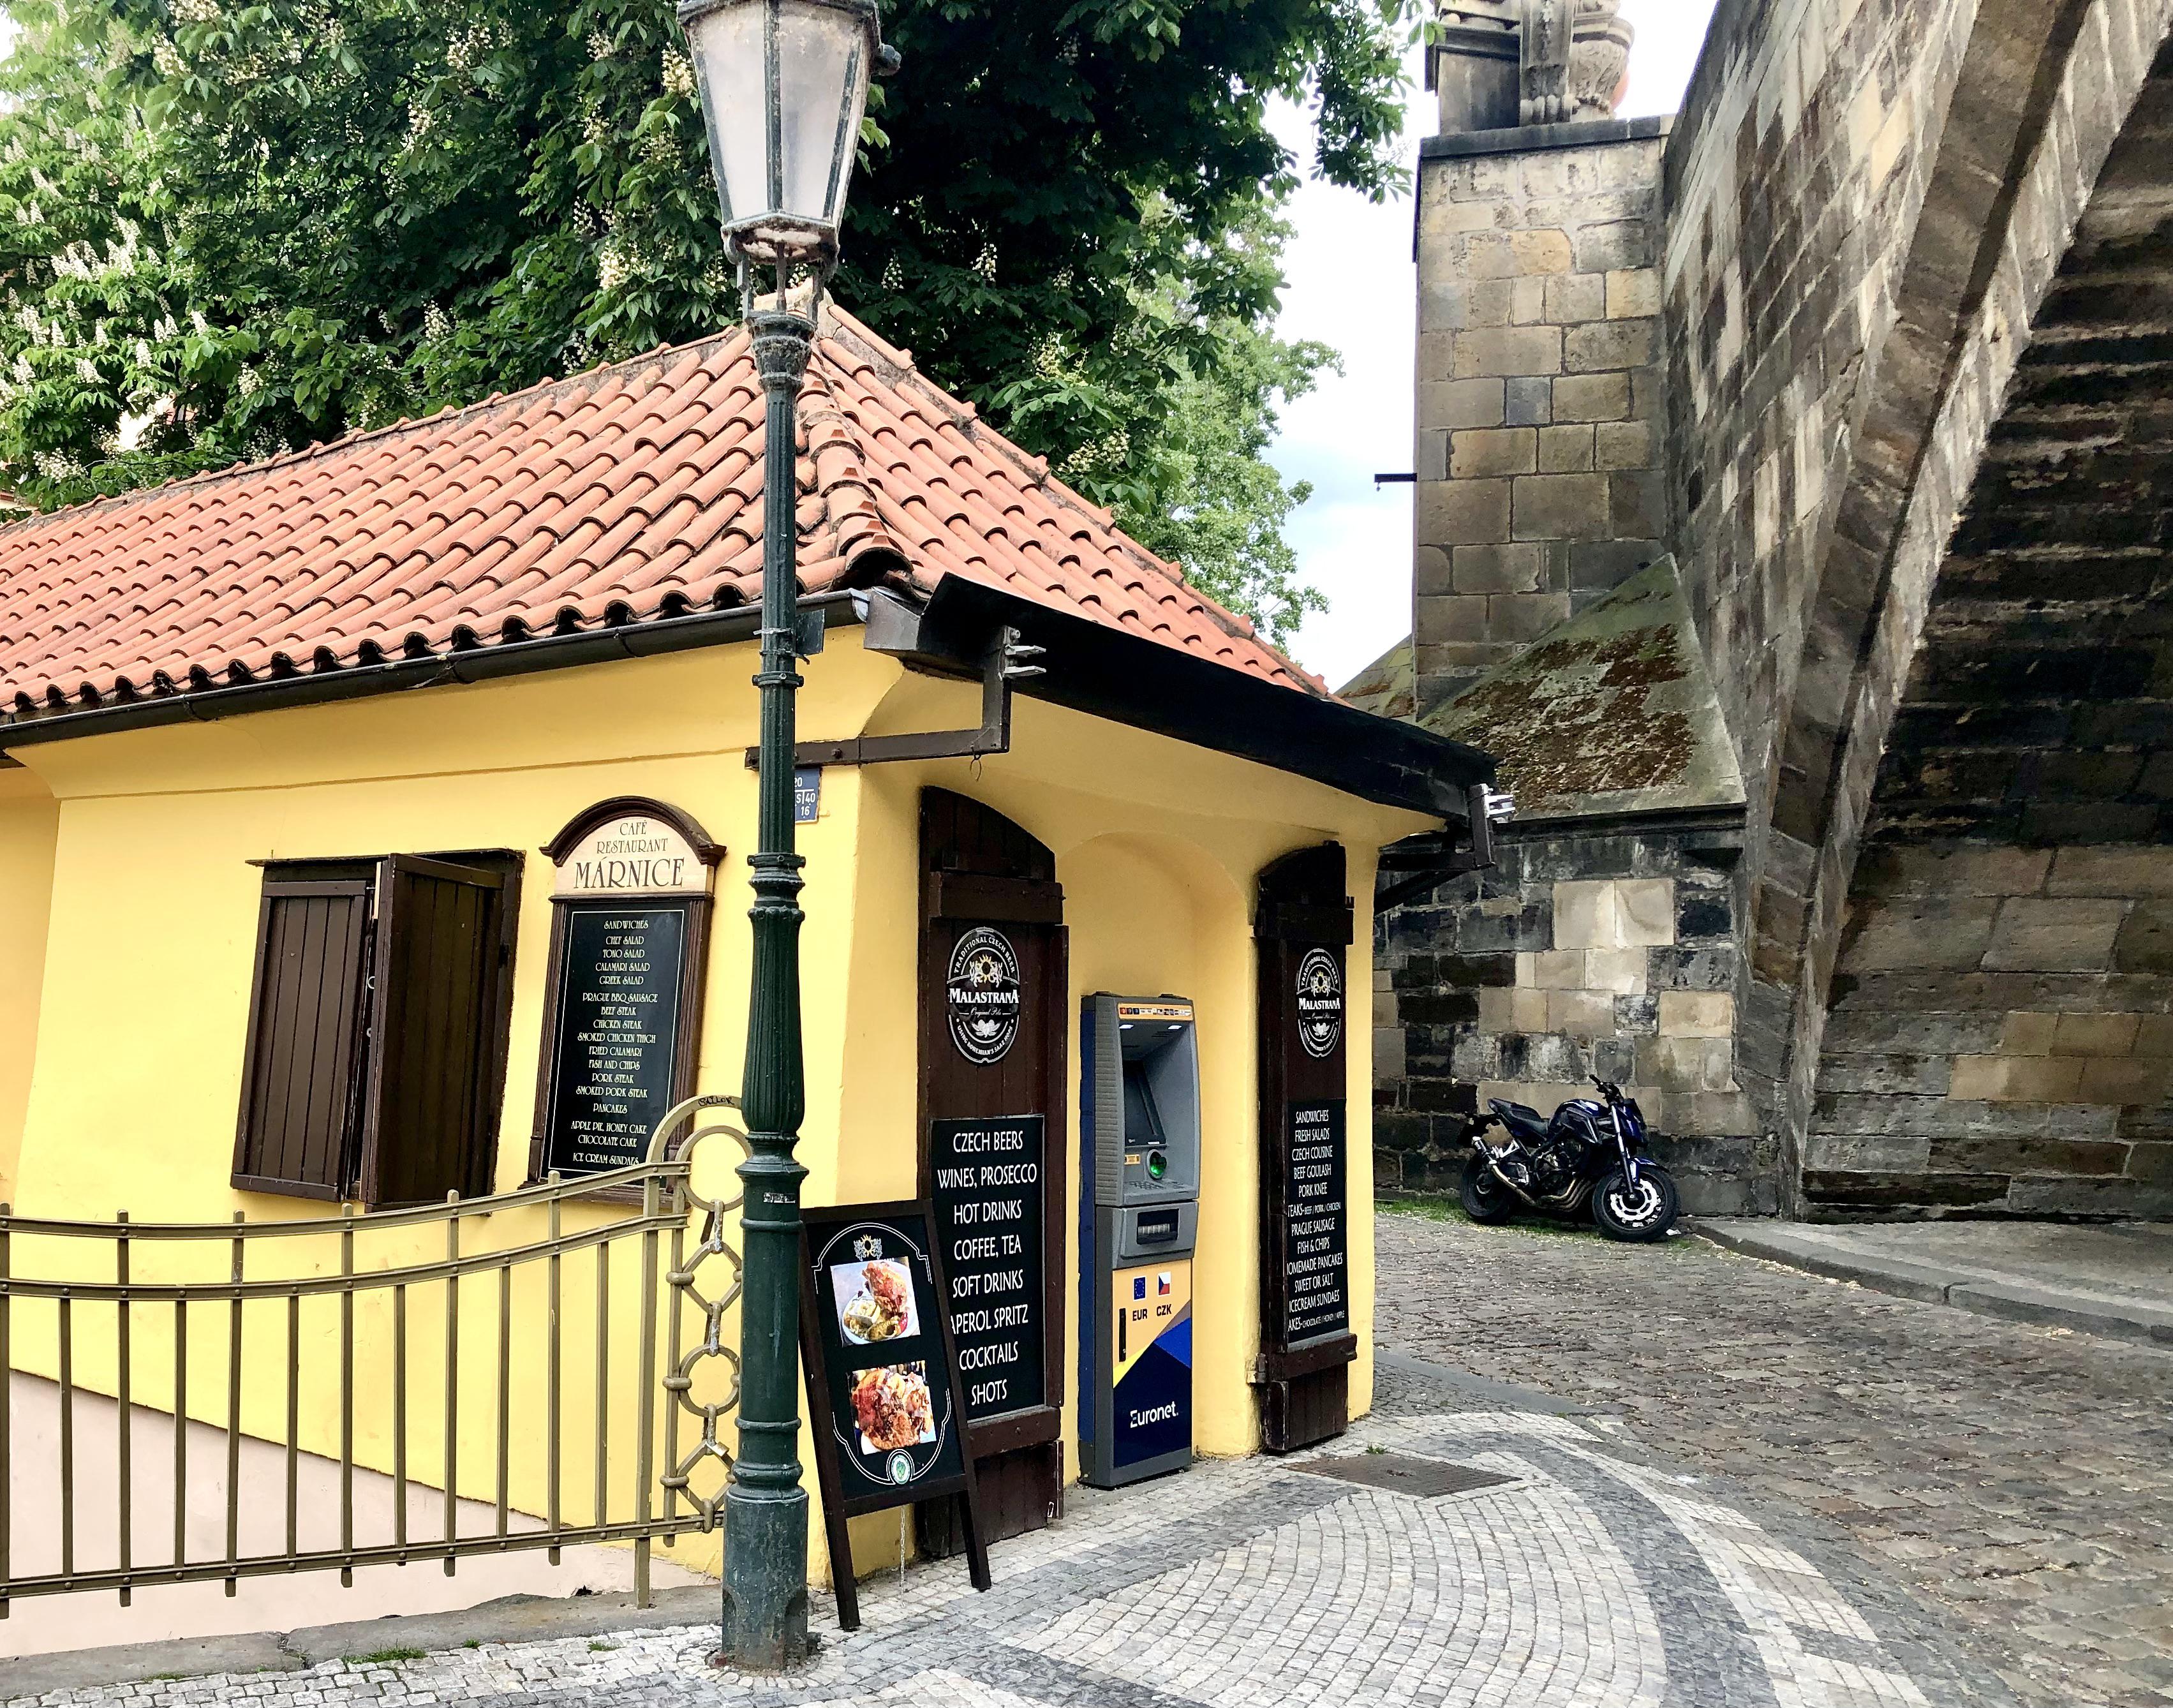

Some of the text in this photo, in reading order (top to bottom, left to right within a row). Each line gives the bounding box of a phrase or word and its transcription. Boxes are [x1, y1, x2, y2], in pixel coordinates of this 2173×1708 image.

[801, 806, 810, 816] 16
[619, 820, 648, 836] CAFÉ
[597, 838, 668, 854] RESTAURANT
[574, 856, 685, 889] MÁRNICE
[604, 920, 649, 930] SANDWICHES
[605, 936, 644, 945] CHEF SALAD
[602, 949, 645, 958] TONO SALAD
[954, 936, 1015, 973] TRADITIONAL CZECH BEER
[595, 962, 650, 972] CALAMARI SALAD
[599, 976, 644, 985] GREEK SALAD
[582, 993, 658, 1004] PRAGUE BBQ SAUSAGE
[601, 1006, 637, 1016] BEEF STEAK
[593, 1020, 642, 1029] CHICKEN STEAK
[577, 1032, 656, 1044] SMOKED CHICKEN THIGH
[589, 1046, 642, 1057] FRIED CALAMARI
[588, 1060, 641, 1071] FISH AND CHIPS
[592, 1073, 634, 1083] PORK STEAK
[576, 1086, 648, 1098] SMOKED PORK STEAK
[593, 1103, 628, 1113] PANCAKES
[1296, 1110, 1329, 1124] SANDWICHES
[571, 1121, 591, 1131] APPLE
[606, 1122, 628, 1133] HONEY
[629, 1124, 647, 1134] CAKE
[578, 1134, 637, 1147] CHOCOLATE CAKE
[953, 1131, 1023, 1152] CZECH BEERS
[1295, 1128, 1330, 1142] FRESH SALADS
[573, 1152, 639, 1166] ICE CREAM SUNDAES
[1292, 1148, 1309, 1161] CZECH
[937, 1163, 1037, 1189] WINES, PROSECCO
[1294, 1164, 1331, 1179] BEEF GOULASH
[1298, 1182, 1328, 1198] PORK KNEE
[954, 1199, 1022, 1224] HOT DRINKS
[1291, 1218, 1335, 1236] PRAGUE SAUSAGE
[954, 1234, 1022, 1261] COFFEE, TEA
[1297, 1237, 1330, 1254] FISH & CHIPS
[1317, 1252, 1343, 1269] PANCAKES
[953, 1269, 1023, 1298] SOFT DRINKS
[1294, 1273, 1333, 1293] SWEET OR SALT
[1317, 1289, 1340, 1305] SUNDAES
[994, 1303, 1028, 1328] SPRITZ
[1132, 1304, 1172, 1321] EUR CZK
[959, 1341, 1018, 1370] COCKTAILS
[971, 1379, 1007, 1406] SHOTS
